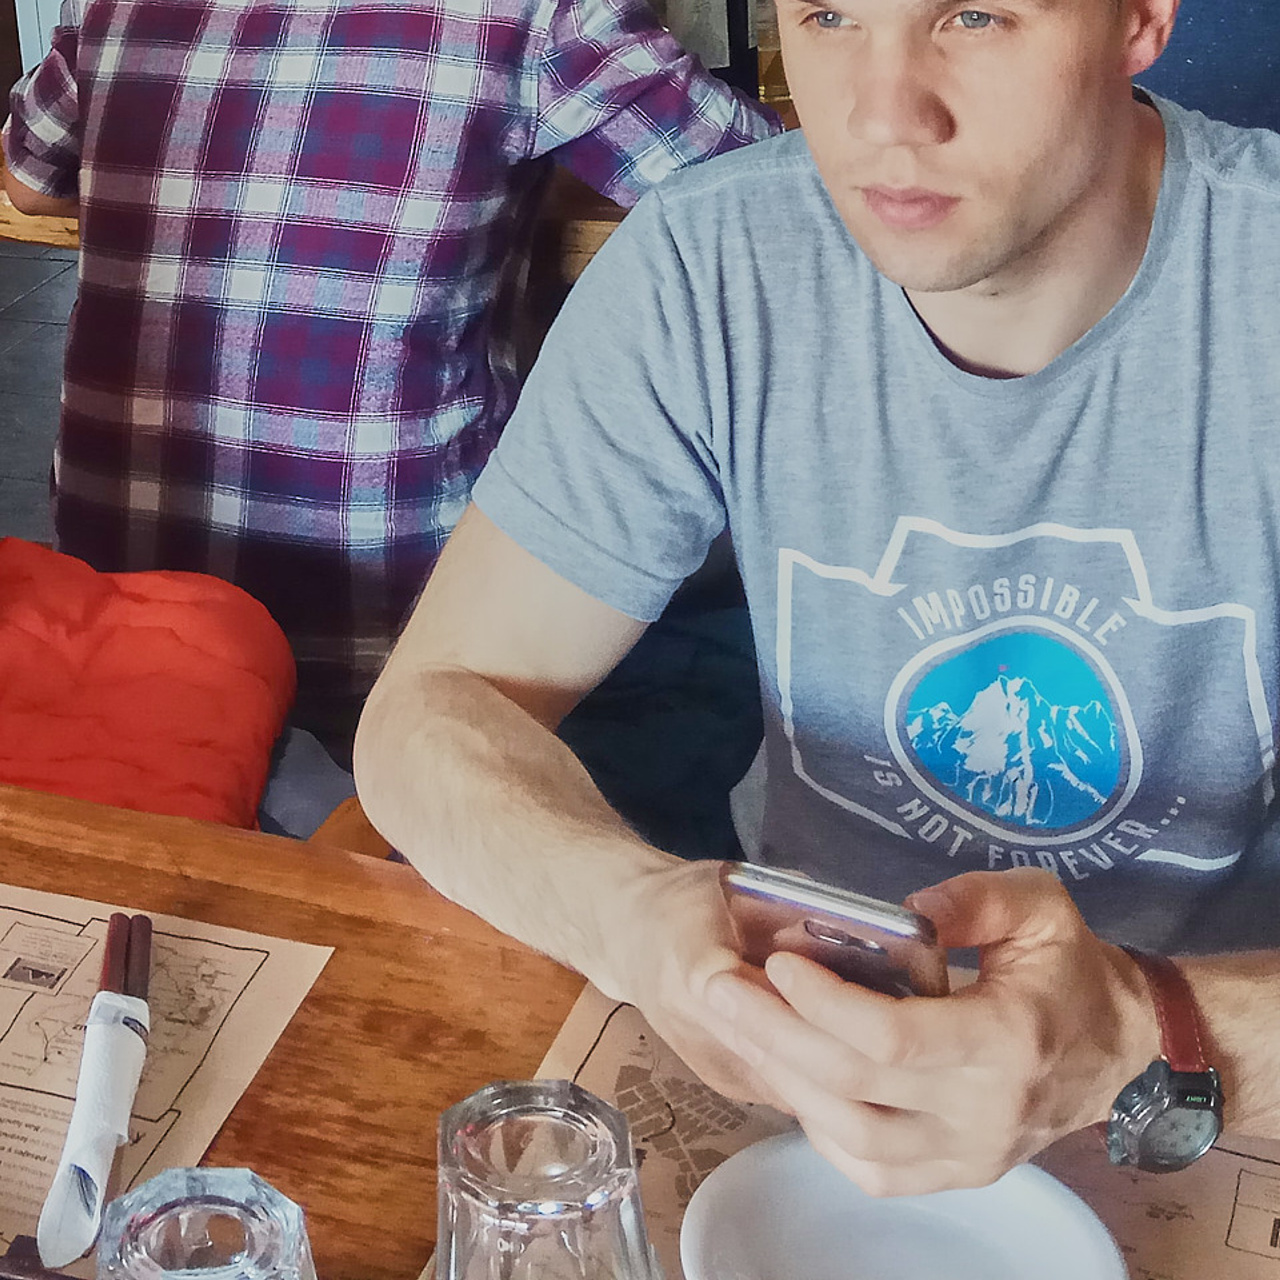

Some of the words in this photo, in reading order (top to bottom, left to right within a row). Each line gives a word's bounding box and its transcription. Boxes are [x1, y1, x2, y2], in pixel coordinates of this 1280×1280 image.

[897, 573, 1128, 648] IMPOSSIBLE
[863, 753, 903, 789] IS
[895, 797, 974, 858] NOT
